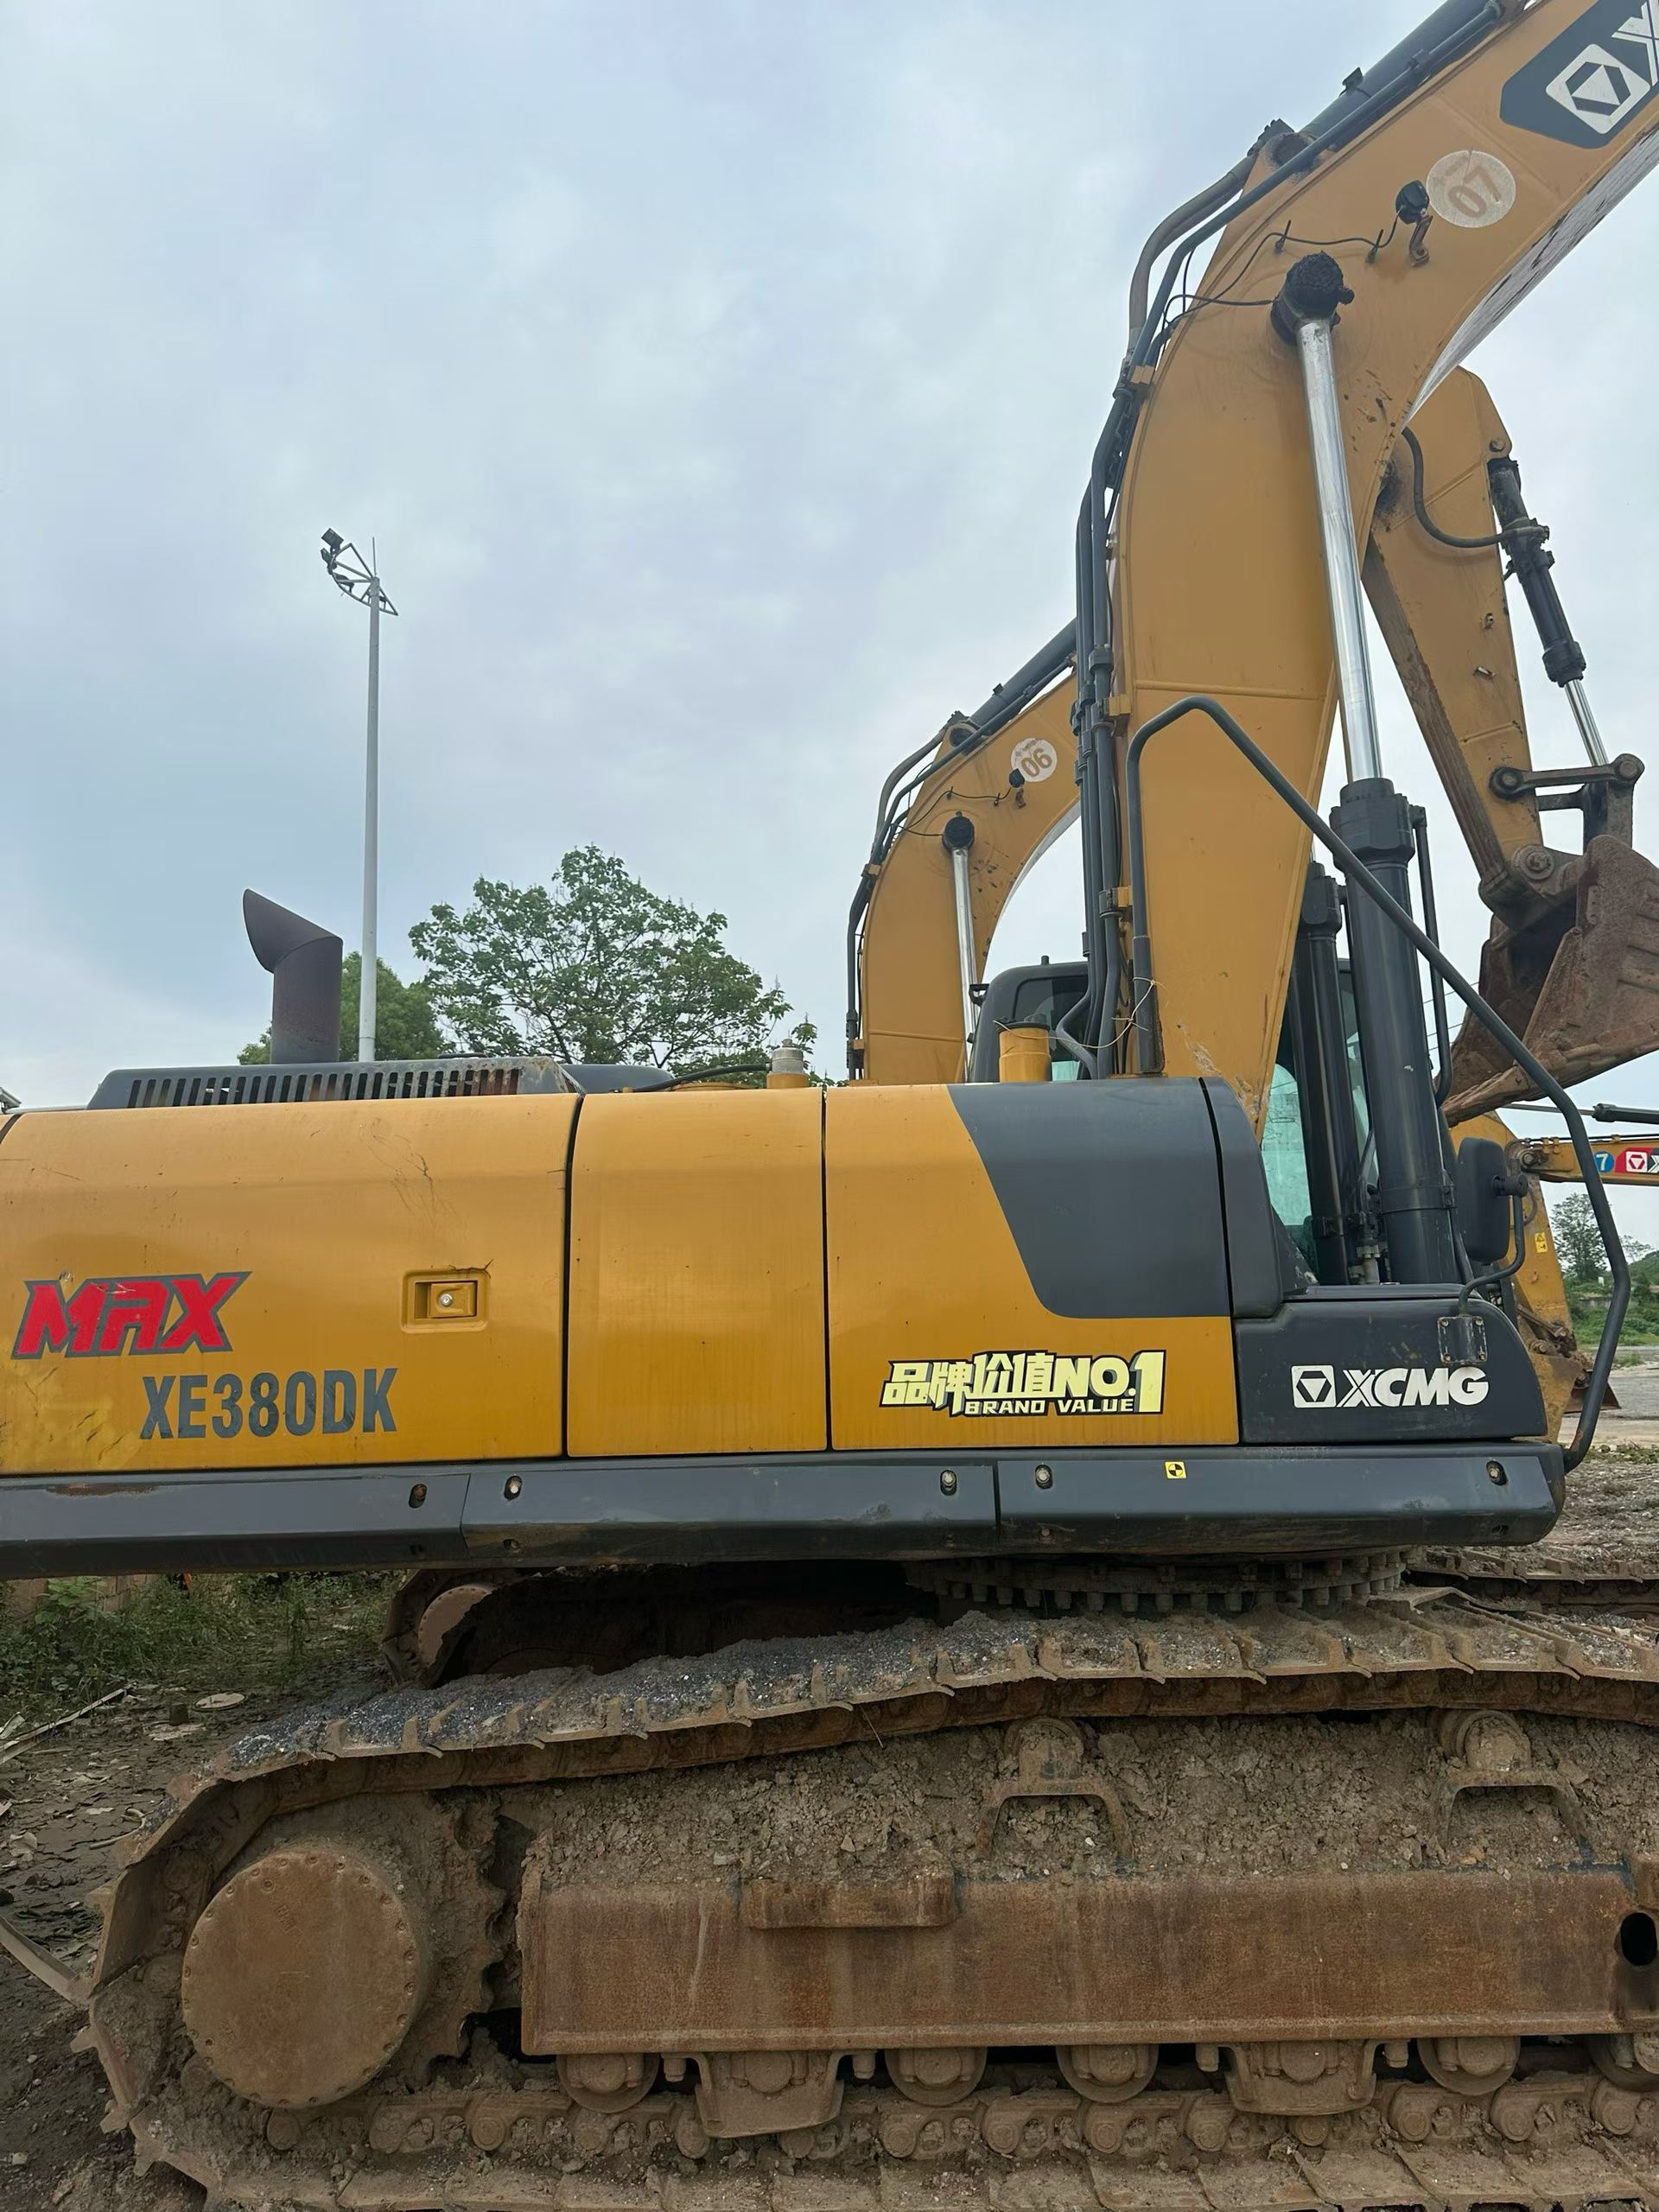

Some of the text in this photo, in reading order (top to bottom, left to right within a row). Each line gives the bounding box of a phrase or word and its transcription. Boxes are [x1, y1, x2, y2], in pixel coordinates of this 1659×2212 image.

[1448, 163, 1502, 219] 07
[1020, 748, 1052, 778] 06
[1596, 1154, 1609, 1171] 7
[11, 1271, 252, 1359] MAX
[140, 1368, 398, 1440] XE380DK
[965, 1398, 1134, 1414] BRAND VALUE
[1336, 1367, 1489, 1408] XCMG
